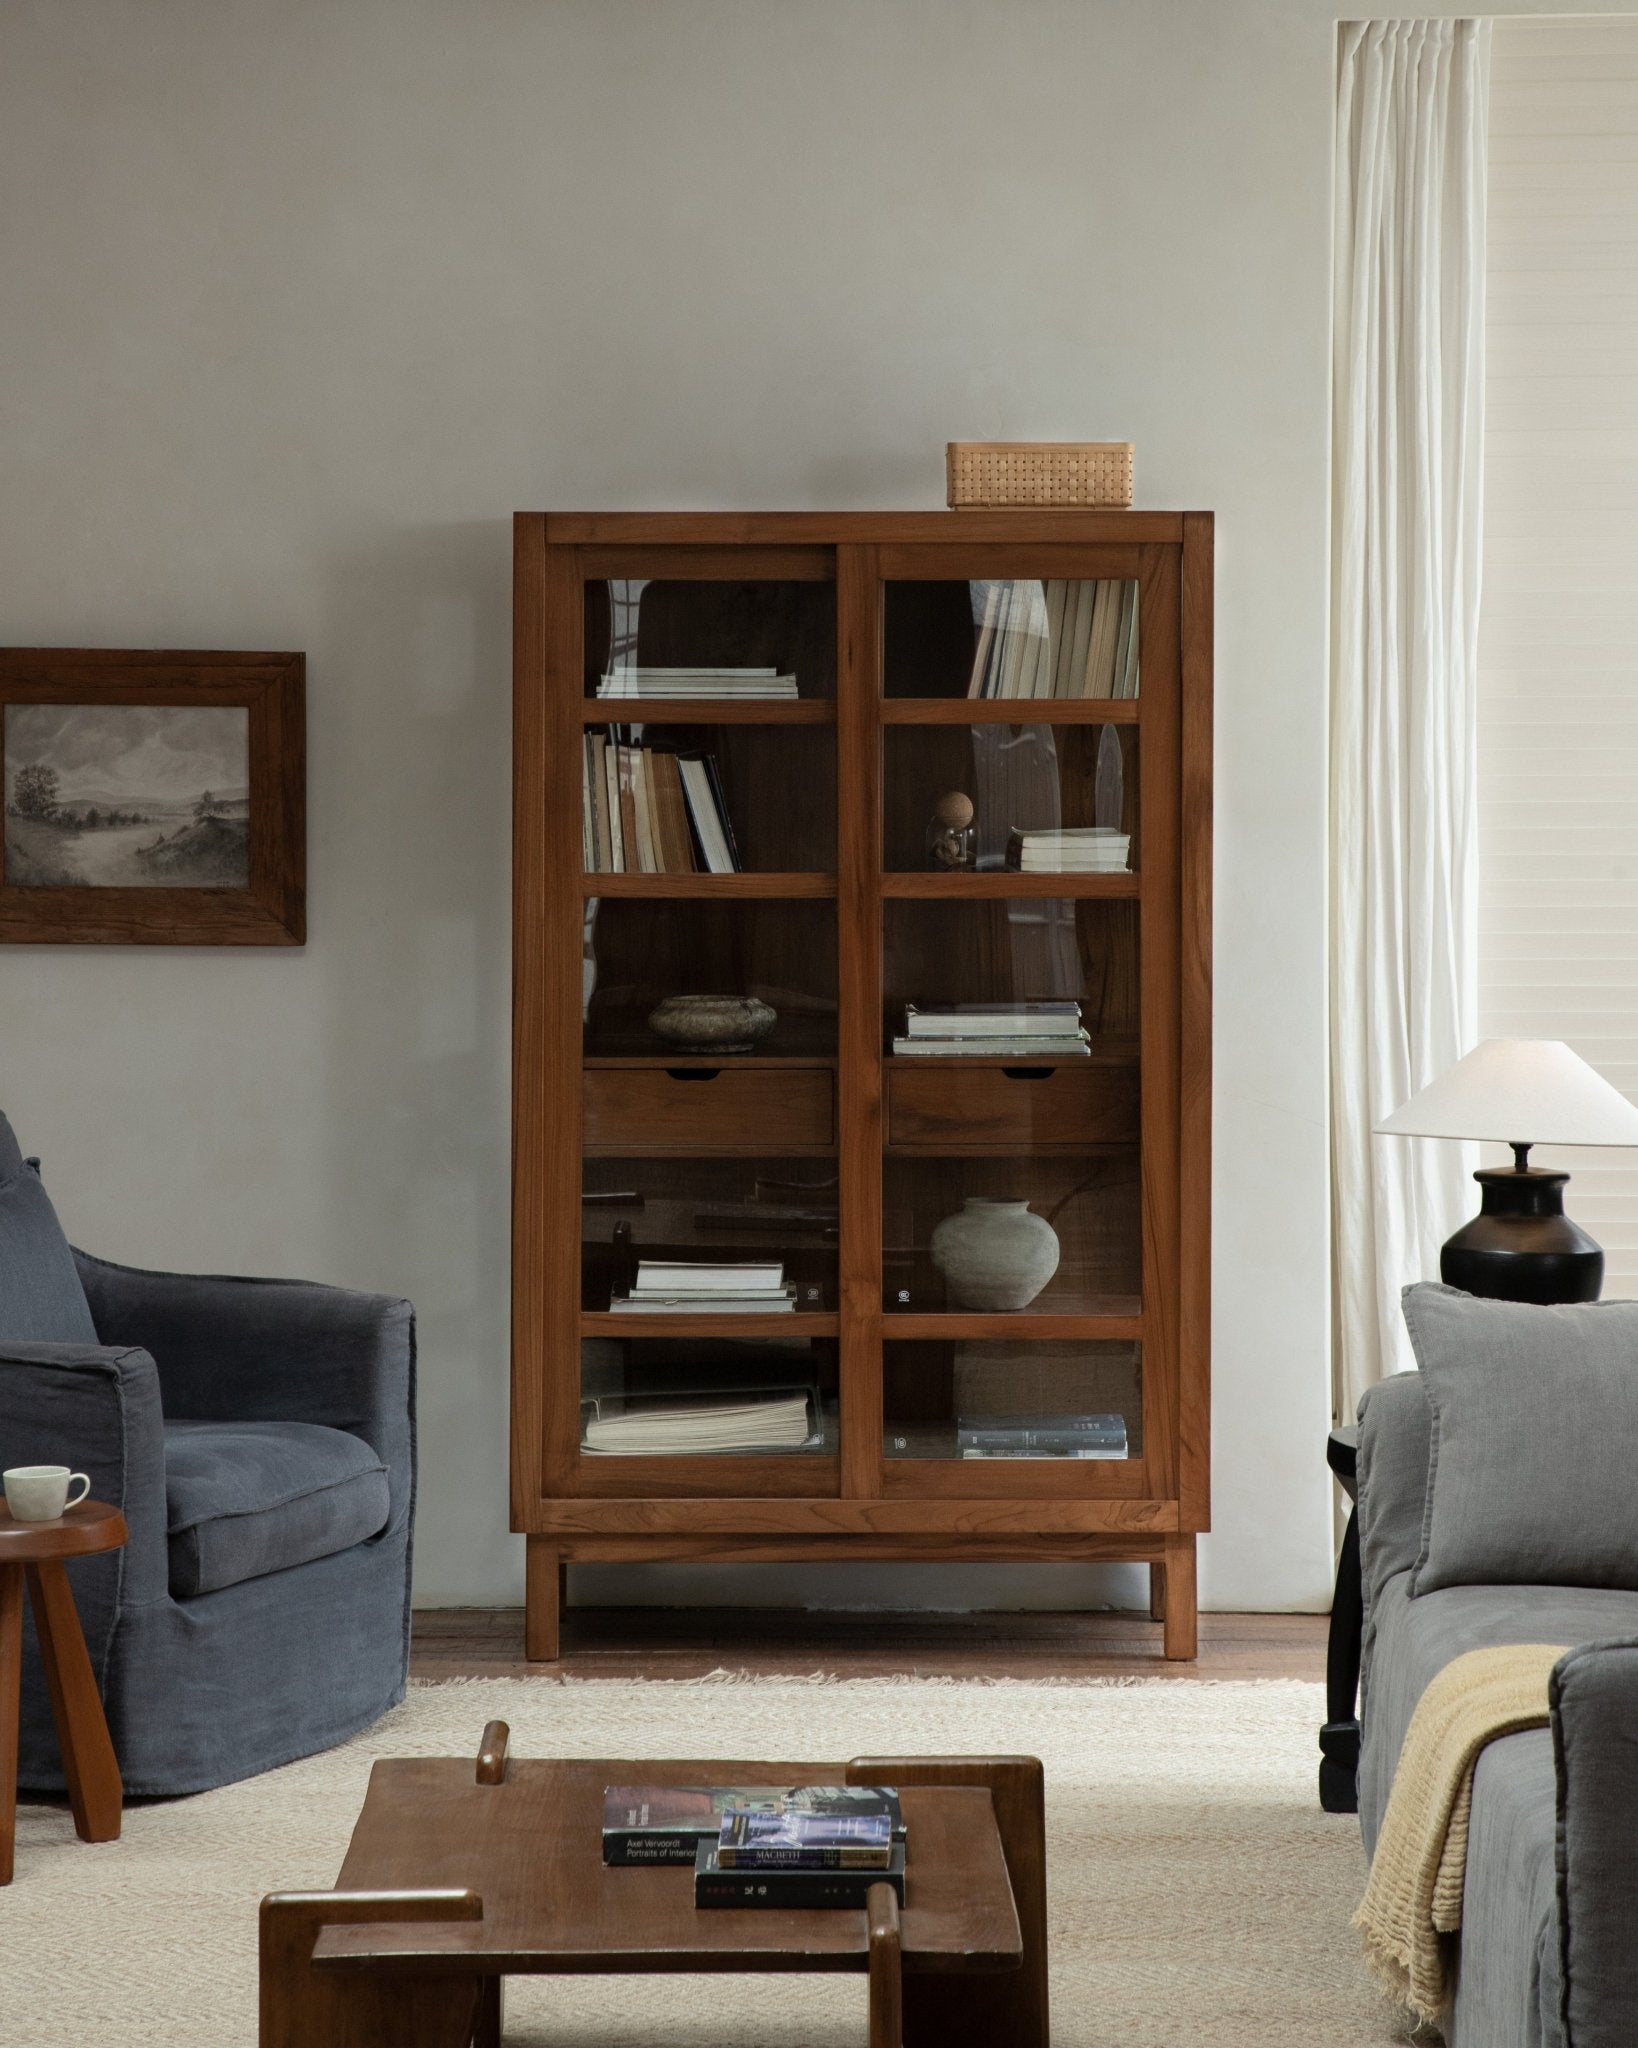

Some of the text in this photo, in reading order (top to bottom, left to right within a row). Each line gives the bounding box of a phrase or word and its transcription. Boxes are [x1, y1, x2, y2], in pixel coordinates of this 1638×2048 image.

[627, 1839, 681, 1848] Axel Vervoordt
[627, 1849, 658, 1858] Portraits
[659, 1849, 668, 1857] of
[756, 1851, 800, 1859] MACBETH
